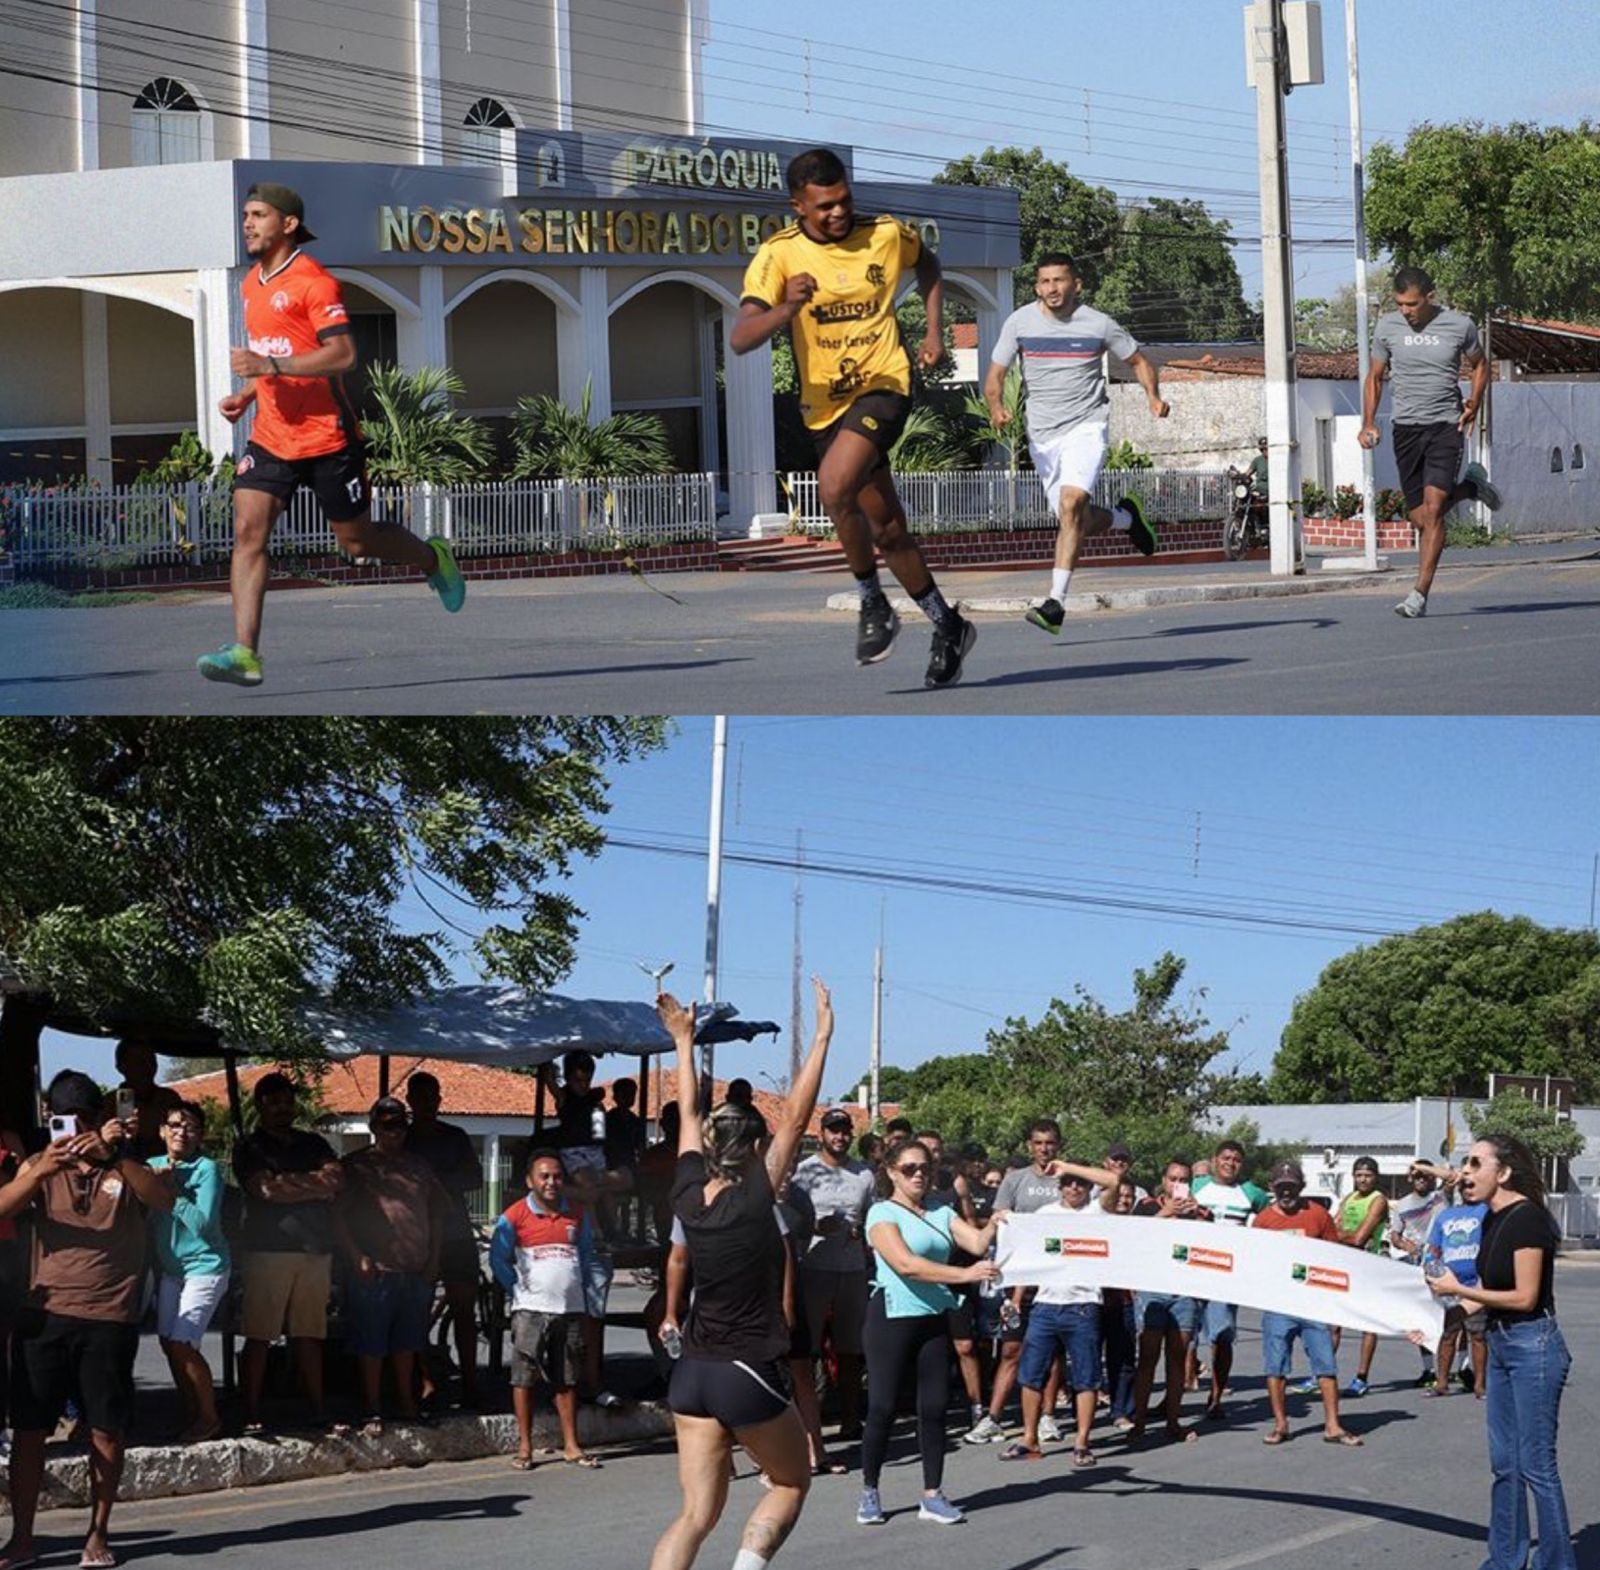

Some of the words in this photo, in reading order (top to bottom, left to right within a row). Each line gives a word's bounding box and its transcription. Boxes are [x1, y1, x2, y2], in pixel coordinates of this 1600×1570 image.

[630, 138, 784, 190] PARÓQUIA
[377, 204, 514, 254] NOSSA
[519, 207, 685, 254] SENHORA
[690, 211, 734, 254] DO
[739, 213, 793, 254] BO
[1404, 335, 1440, 346] BOSS
